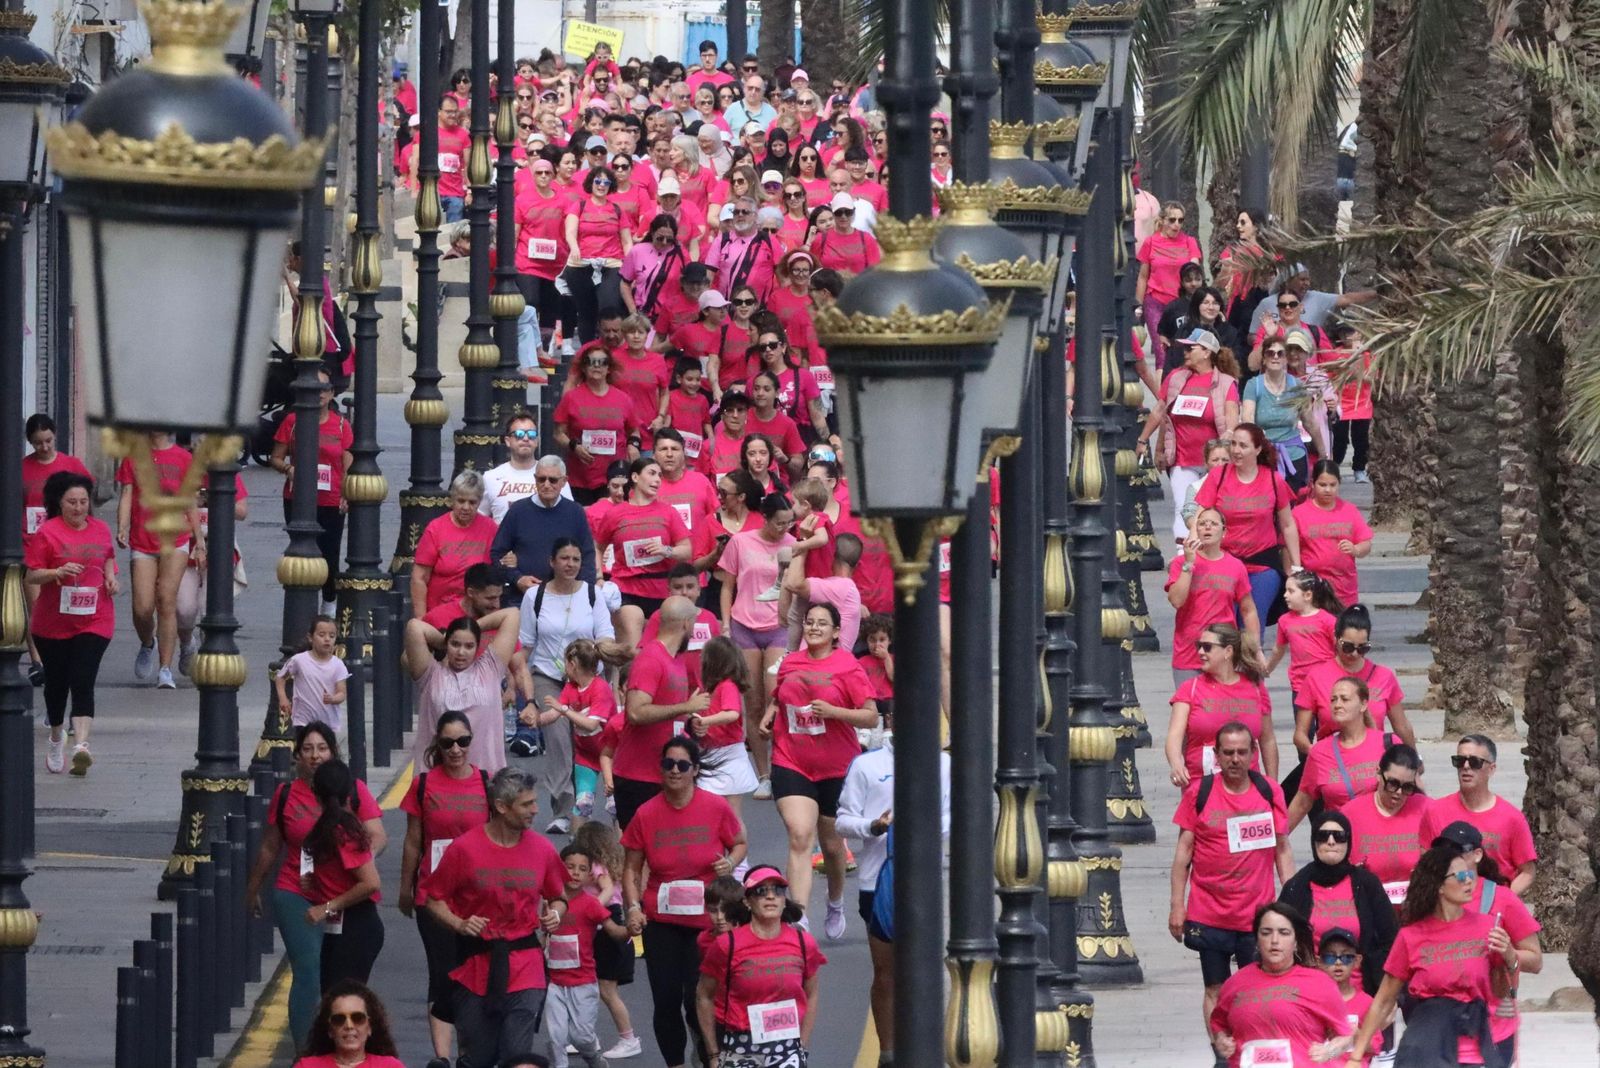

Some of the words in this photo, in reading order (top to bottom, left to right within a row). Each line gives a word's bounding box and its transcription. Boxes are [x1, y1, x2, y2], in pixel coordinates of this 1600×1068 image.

[592, 437, 613, 446] 2857
[497, 481, 537, 497] LAKER
[1241, 824, 1272, 838] 2056
[765, 1012, 797, 1028] 2600
